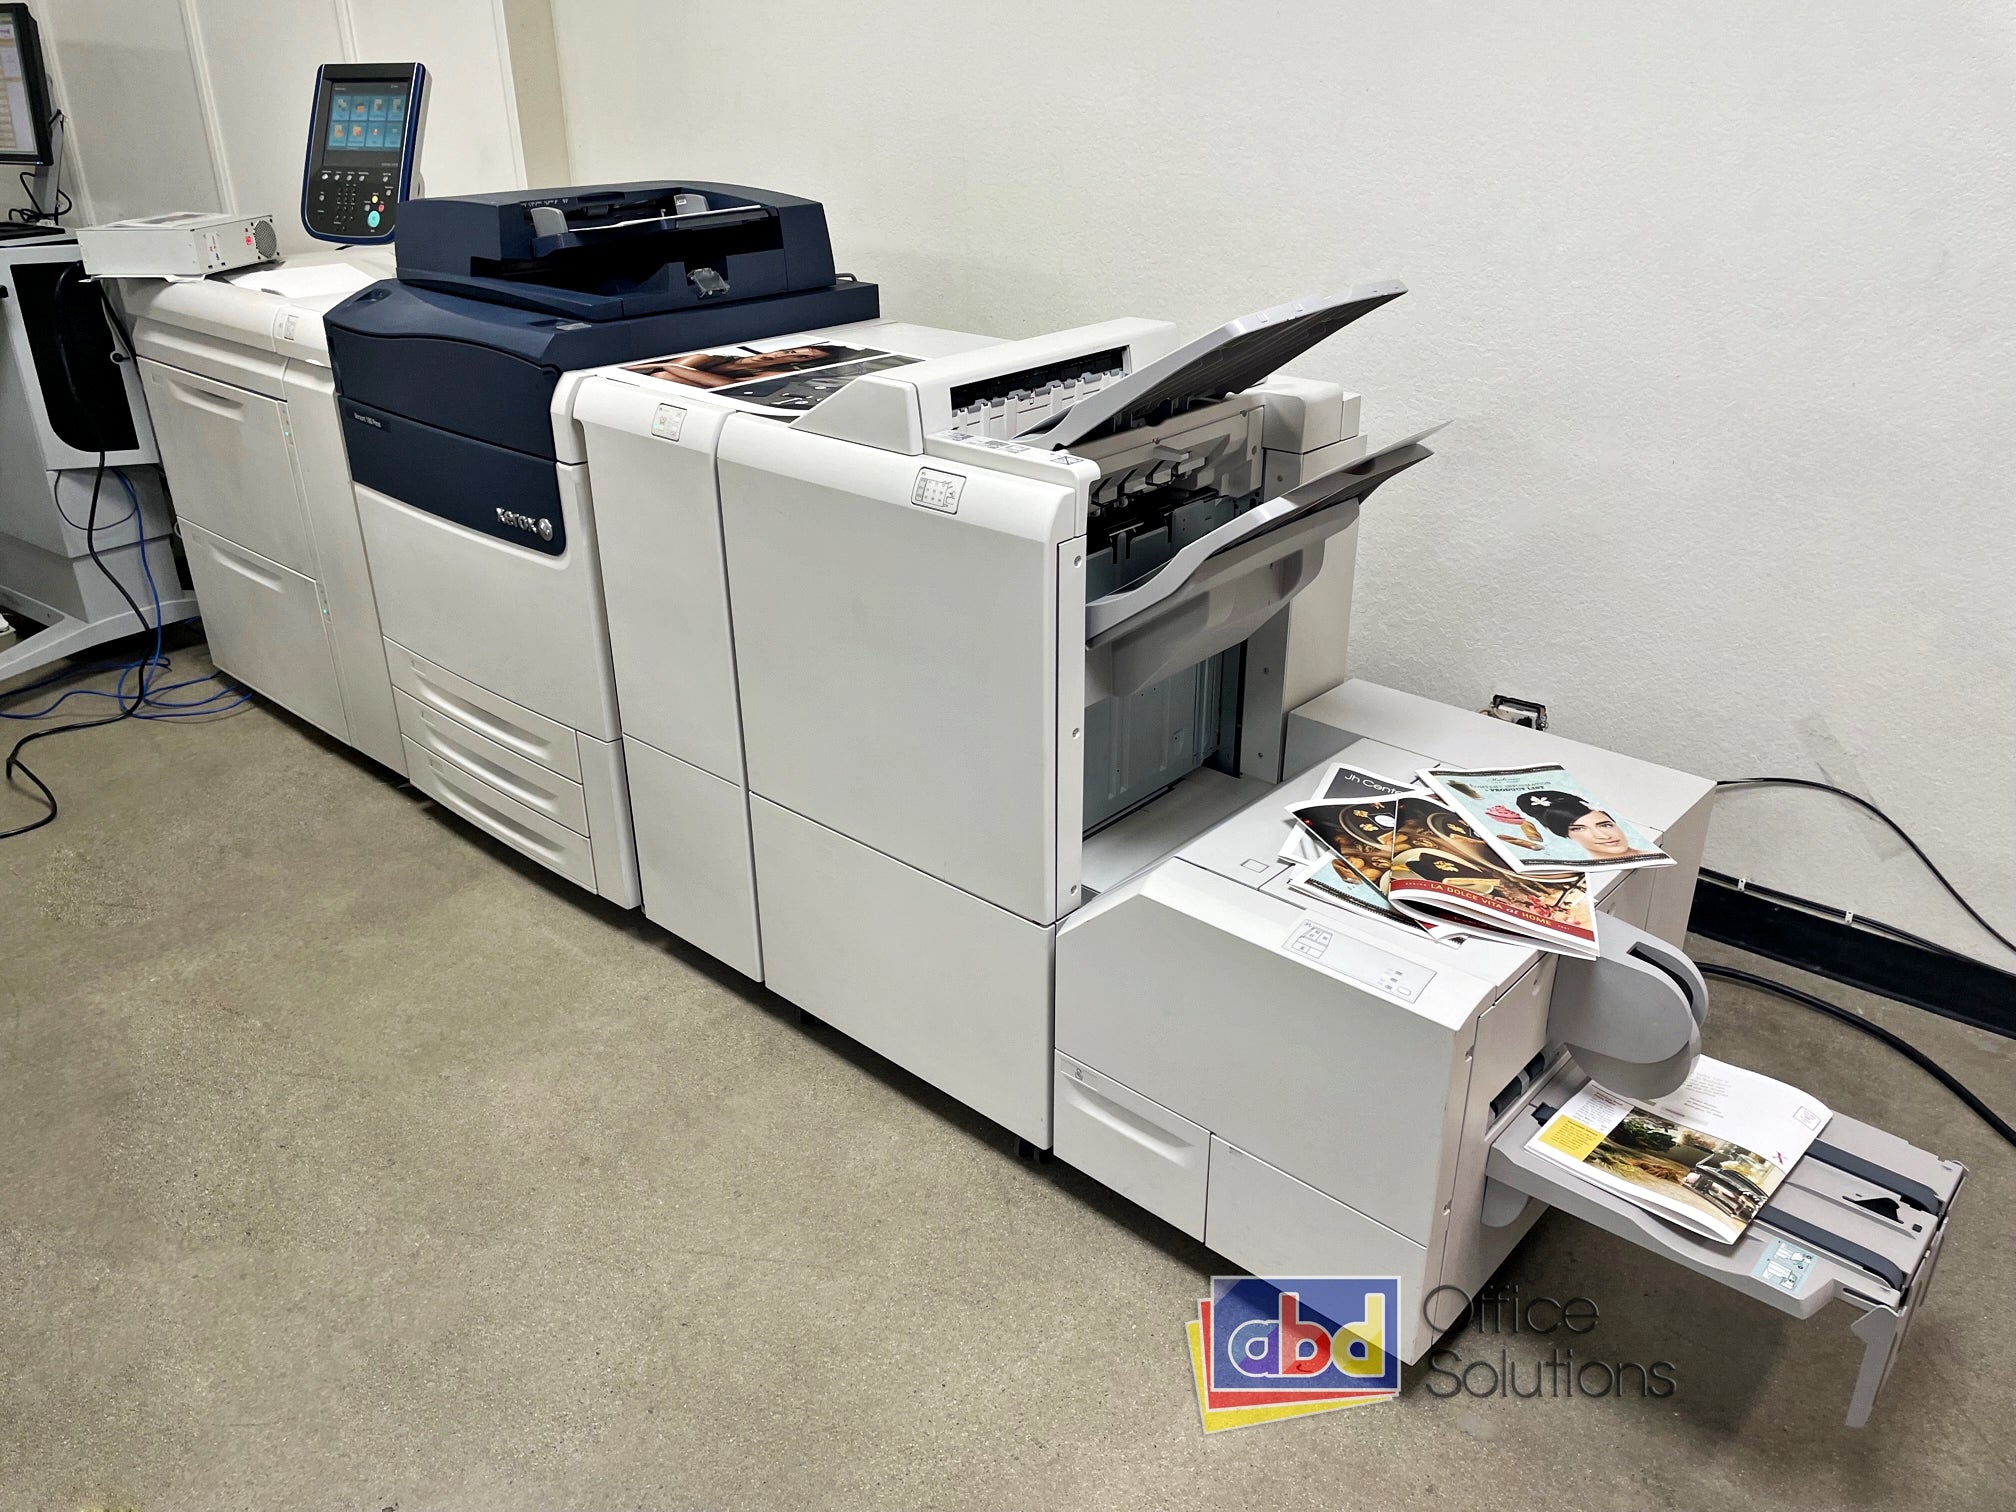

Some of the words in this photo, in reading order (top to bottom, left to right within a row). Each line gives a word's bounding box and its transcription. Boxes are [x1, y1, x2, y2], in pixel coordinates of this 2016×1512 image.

[1344, 774, 1361, 783] Jh
[1430, 883, 1444, 891] LA
[1446, 887, 1478, 900] DOLCE
[1481, 899, 1503, 910] VITA
[1522, 912, 1552, 926] HOME
